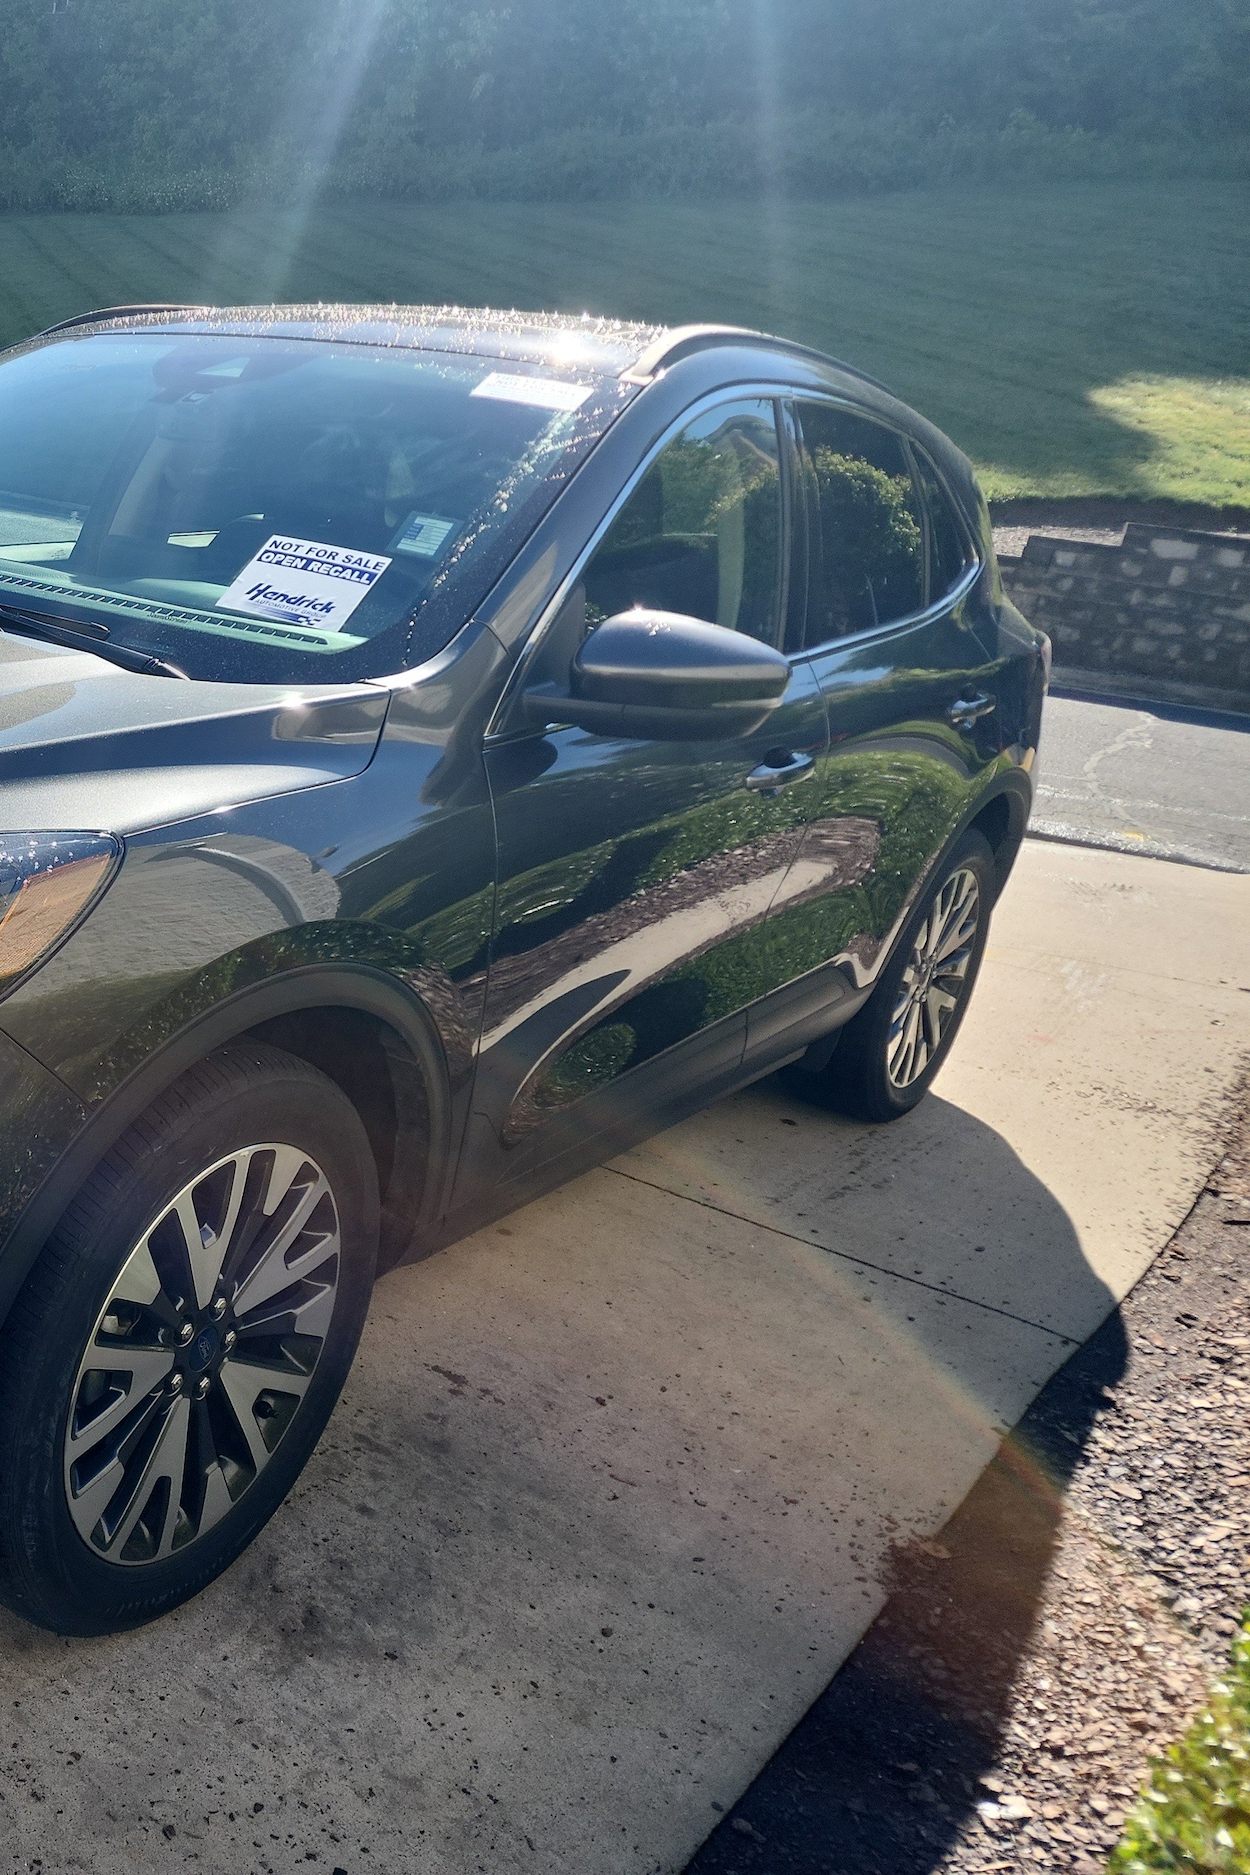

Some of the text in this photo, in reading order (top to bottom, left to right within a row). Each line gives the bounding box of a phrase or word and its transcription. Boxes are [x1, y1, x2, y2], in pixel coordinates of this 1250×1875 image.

[260, 552, 371, 584] OPEN RECALL
[269, 540, 386, 572] NOT FOR SALE
[245, 582, 336, 613] Hendrick
[254, 599, 327, 618] AUTOMOTIVE GROUP
